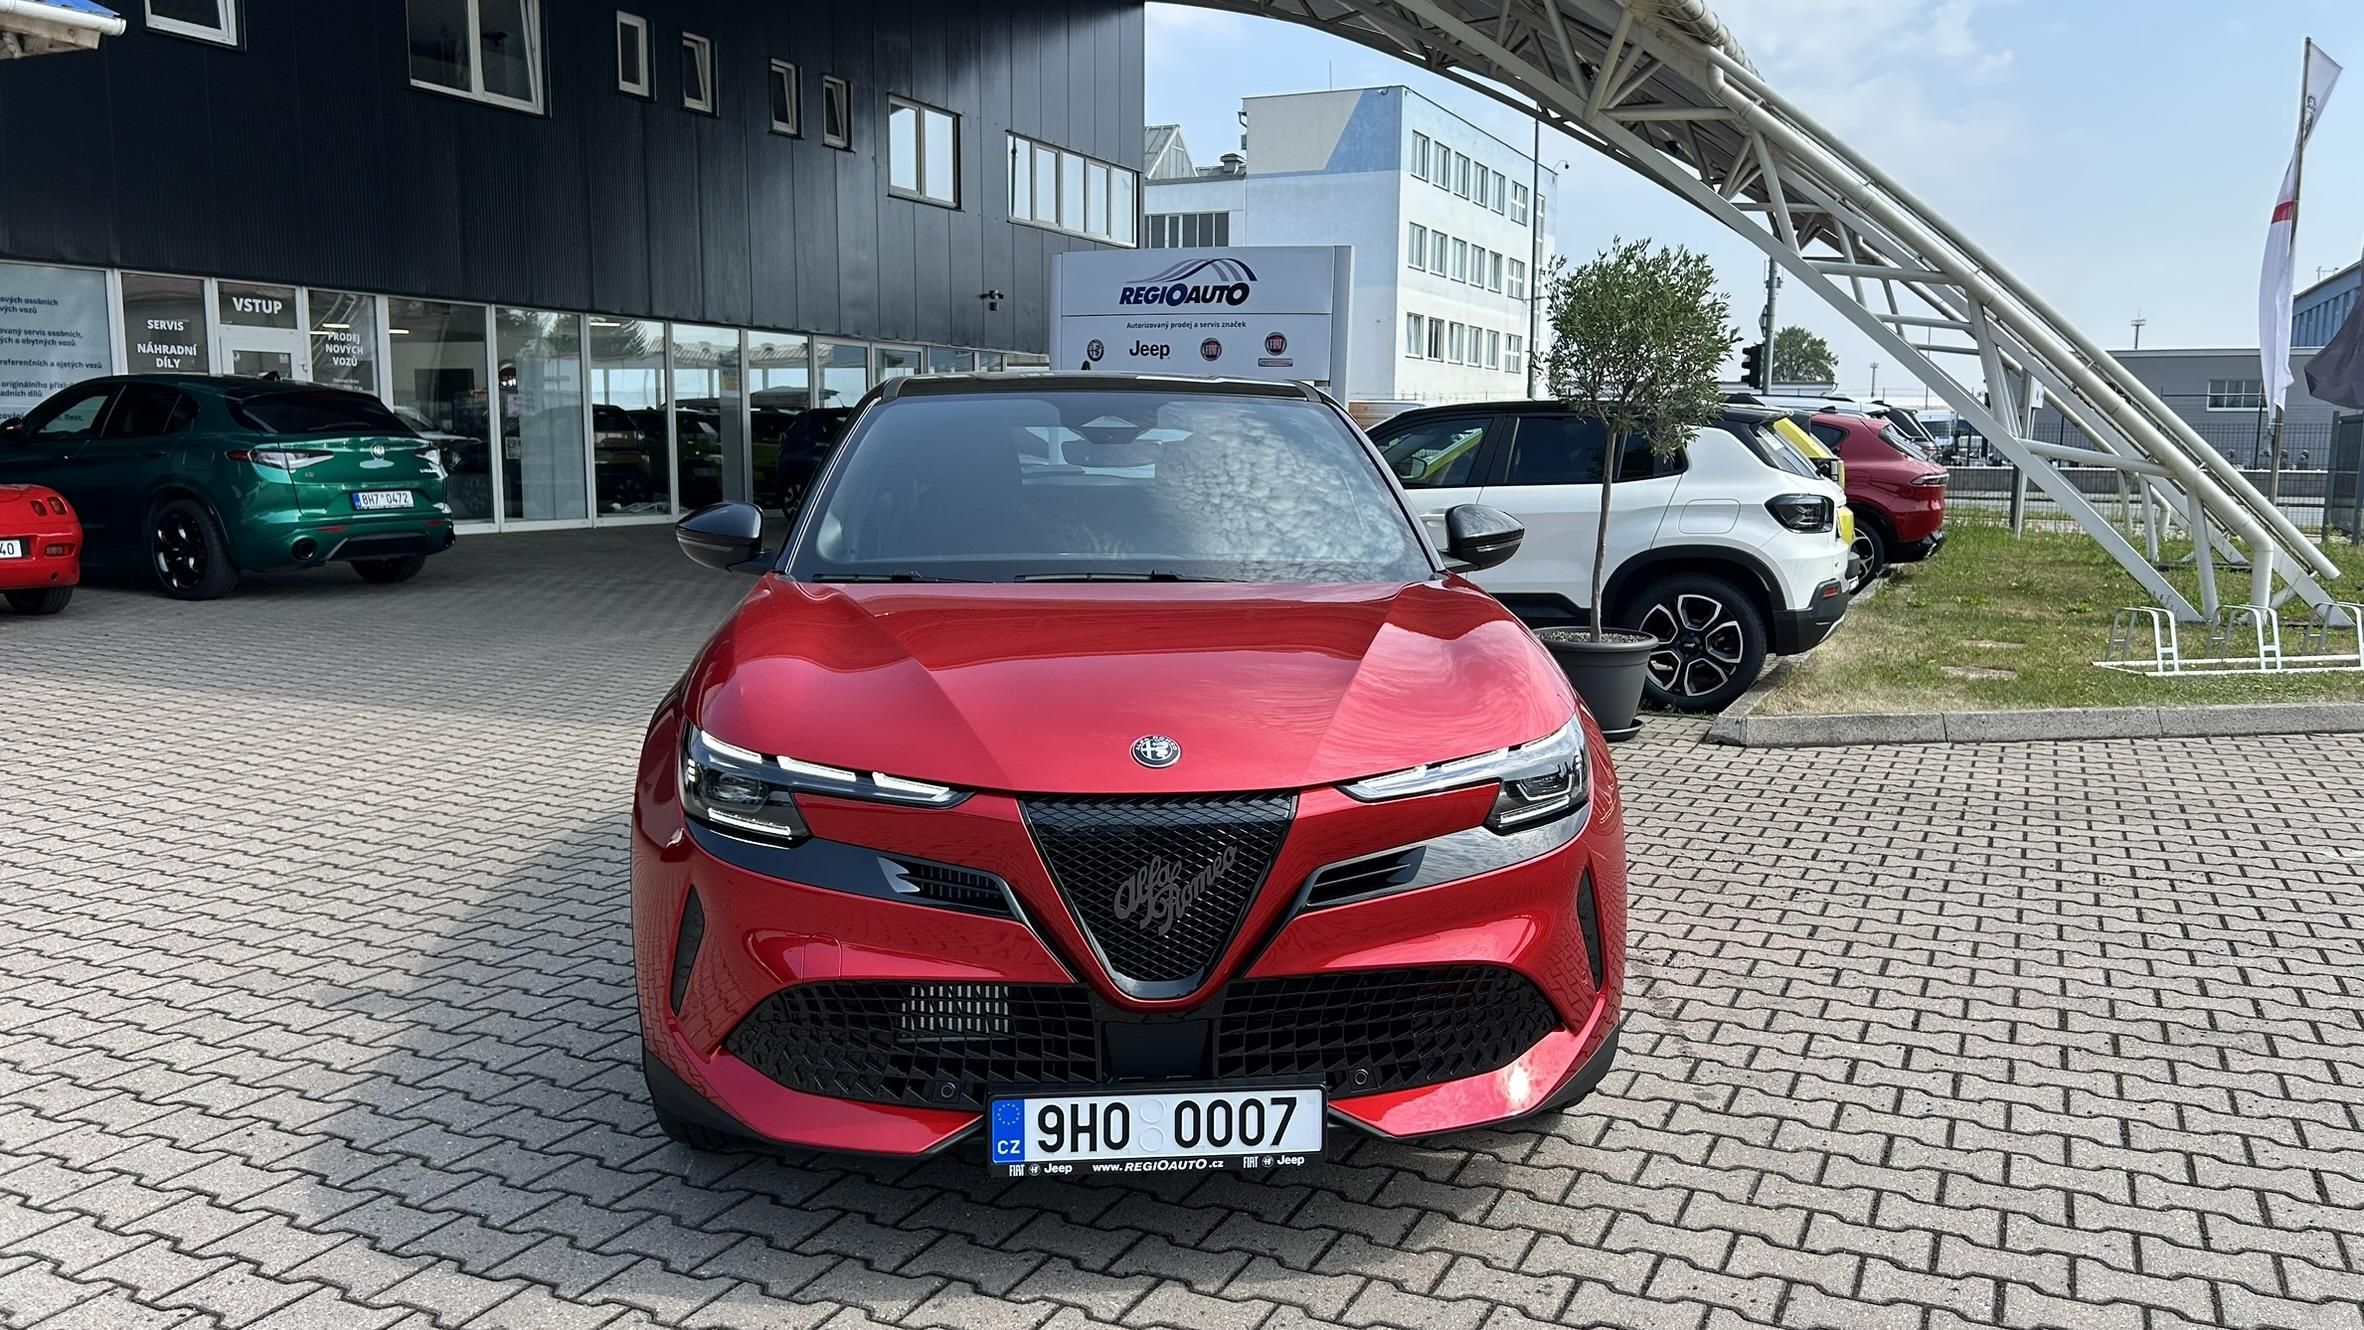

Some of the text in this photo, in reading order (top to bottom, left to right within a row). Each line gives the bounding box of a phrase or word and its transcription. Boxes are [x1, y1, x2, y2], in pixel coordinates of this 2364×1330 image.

[1119, 282, 1251, 306] REGIOAUTO
[24, 297, 59, 306] osobních
[232, 297, 283, 315] VSTUP
[19, 306, 38, 315] vozů
[146, 319, 185, 331] SERVIS
[1126, 321, 1169, 330] Autorizovaný
[1170, 321, 1192, 330] prodej
[1199, 321, 1220, 329] servis
[1221, 320, 1247, 329] značek
[23, 328, 46, 337] servis
[328, 332, 361, 344] PRODEJ
[21, 337, 57, 347] obytných
[58, 339, 76, 347] vozů
[136, 341, 197, 356] NÁHRADNÍ
[325, 343, 364, 355] NOVÝCH
[1129, 340, 1170, 359] Jeep
[56, 360, 84, 370] ojetých
[85, 361, 102, 369] vozů
[155, 356, 181, 369] DÍLY
[332, 355, 358, 367] VOZŮ
[1, 380, 48, 389] originálního
[361, 493, 379, 506] 8H7
[386, 492, 409, 504] 0472
[1113, 854, 1182, 930] Alfa
[1150, 845, 1238, 936] Romeo
[1037, 1096, 1298, 1154] 9H0 0007
[997, 1139, 1021, 1155] CZ
[1009, 1164, 1025, 1177] FIAT
[1044, 1163, 1073, 1175] Jeep
[1243, 1156, 1259, 1169] FIAT
[1276, 1155, 1305, 1166] Jeep
